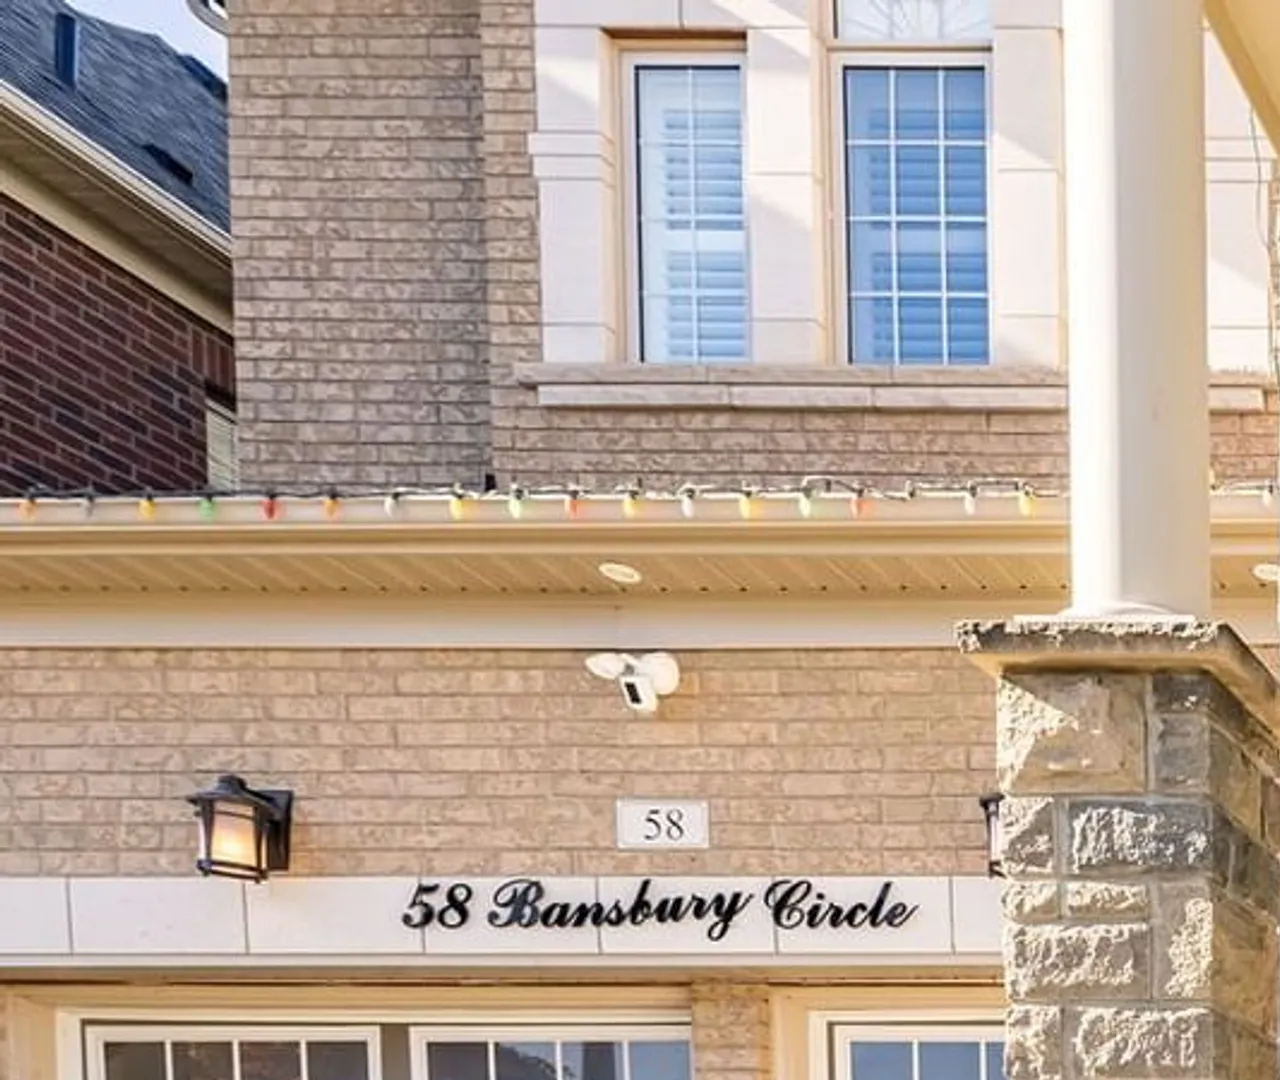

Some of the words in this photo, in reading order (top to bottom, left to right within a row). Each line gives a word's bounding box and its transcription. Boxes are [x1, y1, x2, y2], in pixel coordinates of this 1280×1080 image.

[643, 808, 684, 841] 58
[402, 883, 473, 928] 58
[487, 878, 755, 942] Bansbury
[764, 879, 920, 929] Circle
